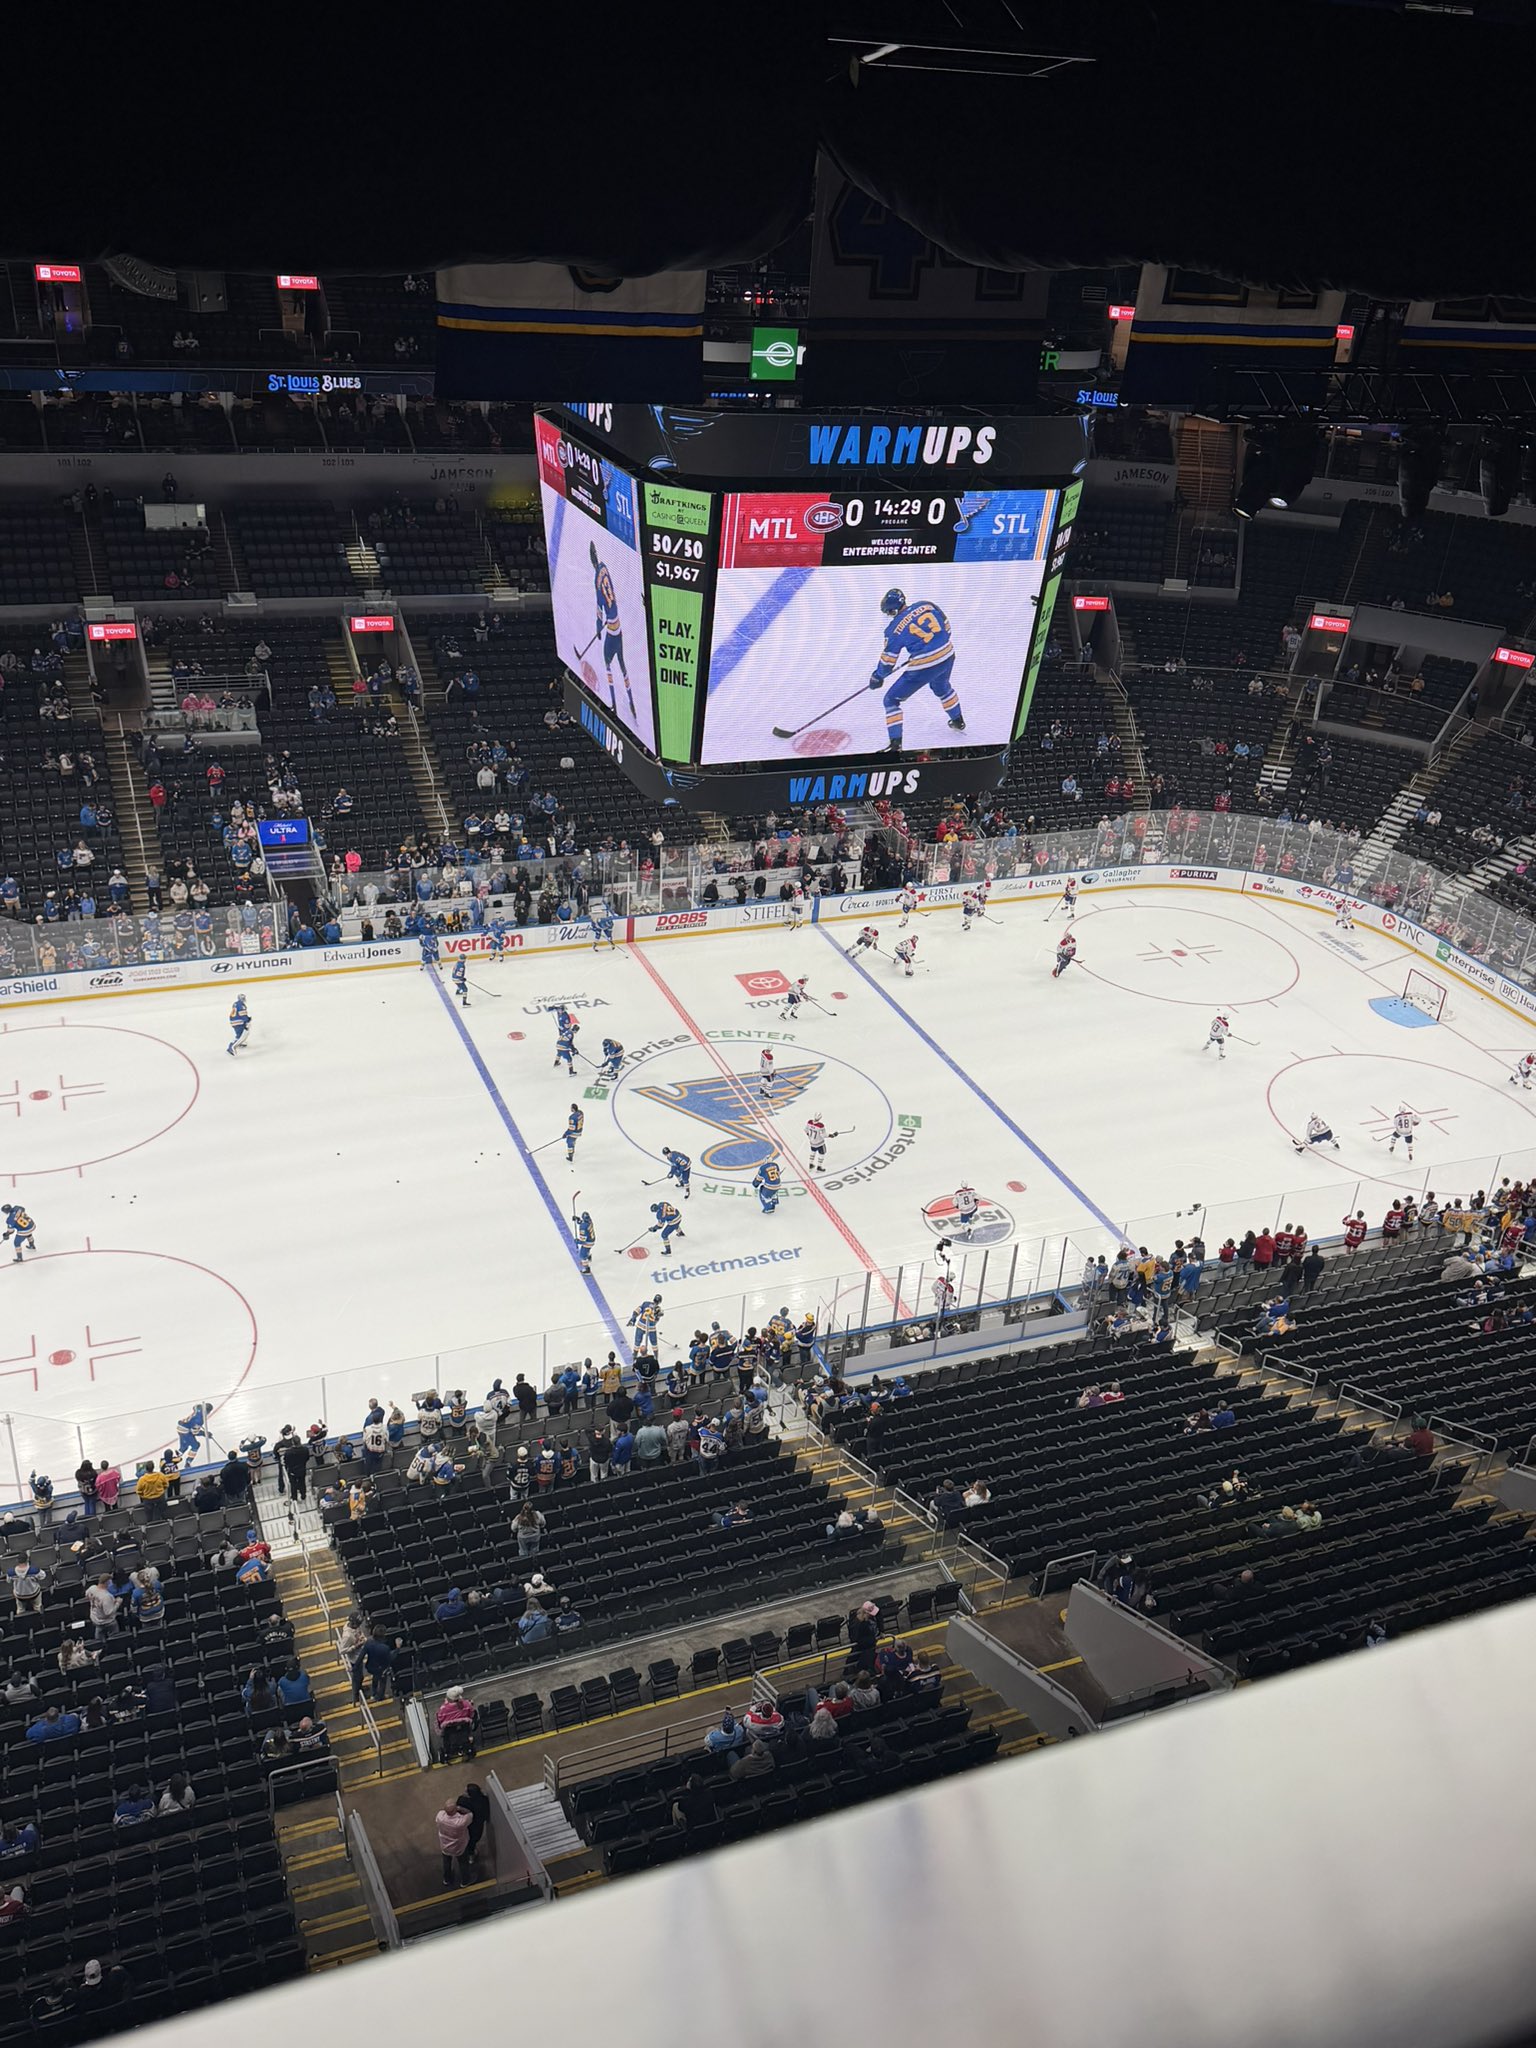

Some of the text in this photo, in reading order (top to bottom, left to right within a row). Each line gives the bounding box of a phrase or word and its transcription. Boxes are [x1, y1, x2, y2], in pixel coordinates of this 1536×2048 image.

[288, 375, 319, 392] LOUIS
[322, 375, 361, 391] BLUES
[1092, 391, 1118, 408] LOUIS
[809, 425, 997, 464] WARMUPS
[542, 440, 558, 467] MTL
[566, 441, 574, 468] 0
[592, 458, 599, 486] 0
[1114, 468, 1169, 484] JAMESON
[615, 490, 632, 520] STL
[651, 496, 707, 511] DRAFTKINGS
[874, 499, 921, 516] 14:29
[927, 497, 946, 525] 0
[651, 511, 707, 526] CASINO QUEEN
[845, 499, 864, 526] 0
[748, 517, 798, 540] MTL
[991, 513, 1030, 535] STL
[653, 533, 703, 559] 50/50
[842, 545, 937, 557] ENTERPRISE CENTER
[656, 560, 700, 580] $1,967
[659, 618, 694, 639] PLAY.
[909, 612, 941, 644] 13
[1324, 621, 1346, 629] TOYOTA
[659, 642, 694, 664] STAY.
[1509, 654, 1531, 664] TOYOTA
[660, 667, 693, 688] DINE.
[790, 769, 920, 803] WARMUPS
[269, 826, 298, 834] ULTRA
[1102, 868, 1141, 880] Gallagher
[1179, 870, 1217, 880] PURINA
[929, 887, 954, 896] FIRST
[1035, 879, 1062, 888] ULTRA
[1263, 885, 1284, 895] YouTube
[840, 897, 869, 913] Circa
[928, 893, 960, 902] COMMU
[657, 911, 707, 927] DOBBS
[743, 905, 788, 921] STIFEL
[1397, 920, 1425, 946] PNC
[323, 947, 401, 962] Edward Jones
[236, 957, 292, 970] HYUNDAI
[1441, 947, 1496, 985] enterprise
[89, 975, 124, 986] Club
[1501, 984, 1536, 1013] BJC Hea
[706, 1030, 796, 1041] CENTER
[1398, 1119, 1409, 1128] 48
[823, 1115, 917, 1191] enterprise
[702, 1183, 807, 1197] CETER
[963, 1196, 970, 1205] 8
[650, 1246, 803, 1284] ticketmaster
[452, 1409, 463, 1417] 63
[422, 1419, 435, 1430] 25
[370, 1435, 382, 1446] 16
[702, 1441, 717, 1453] 44
[562, 1462, 573, 1473] 21
